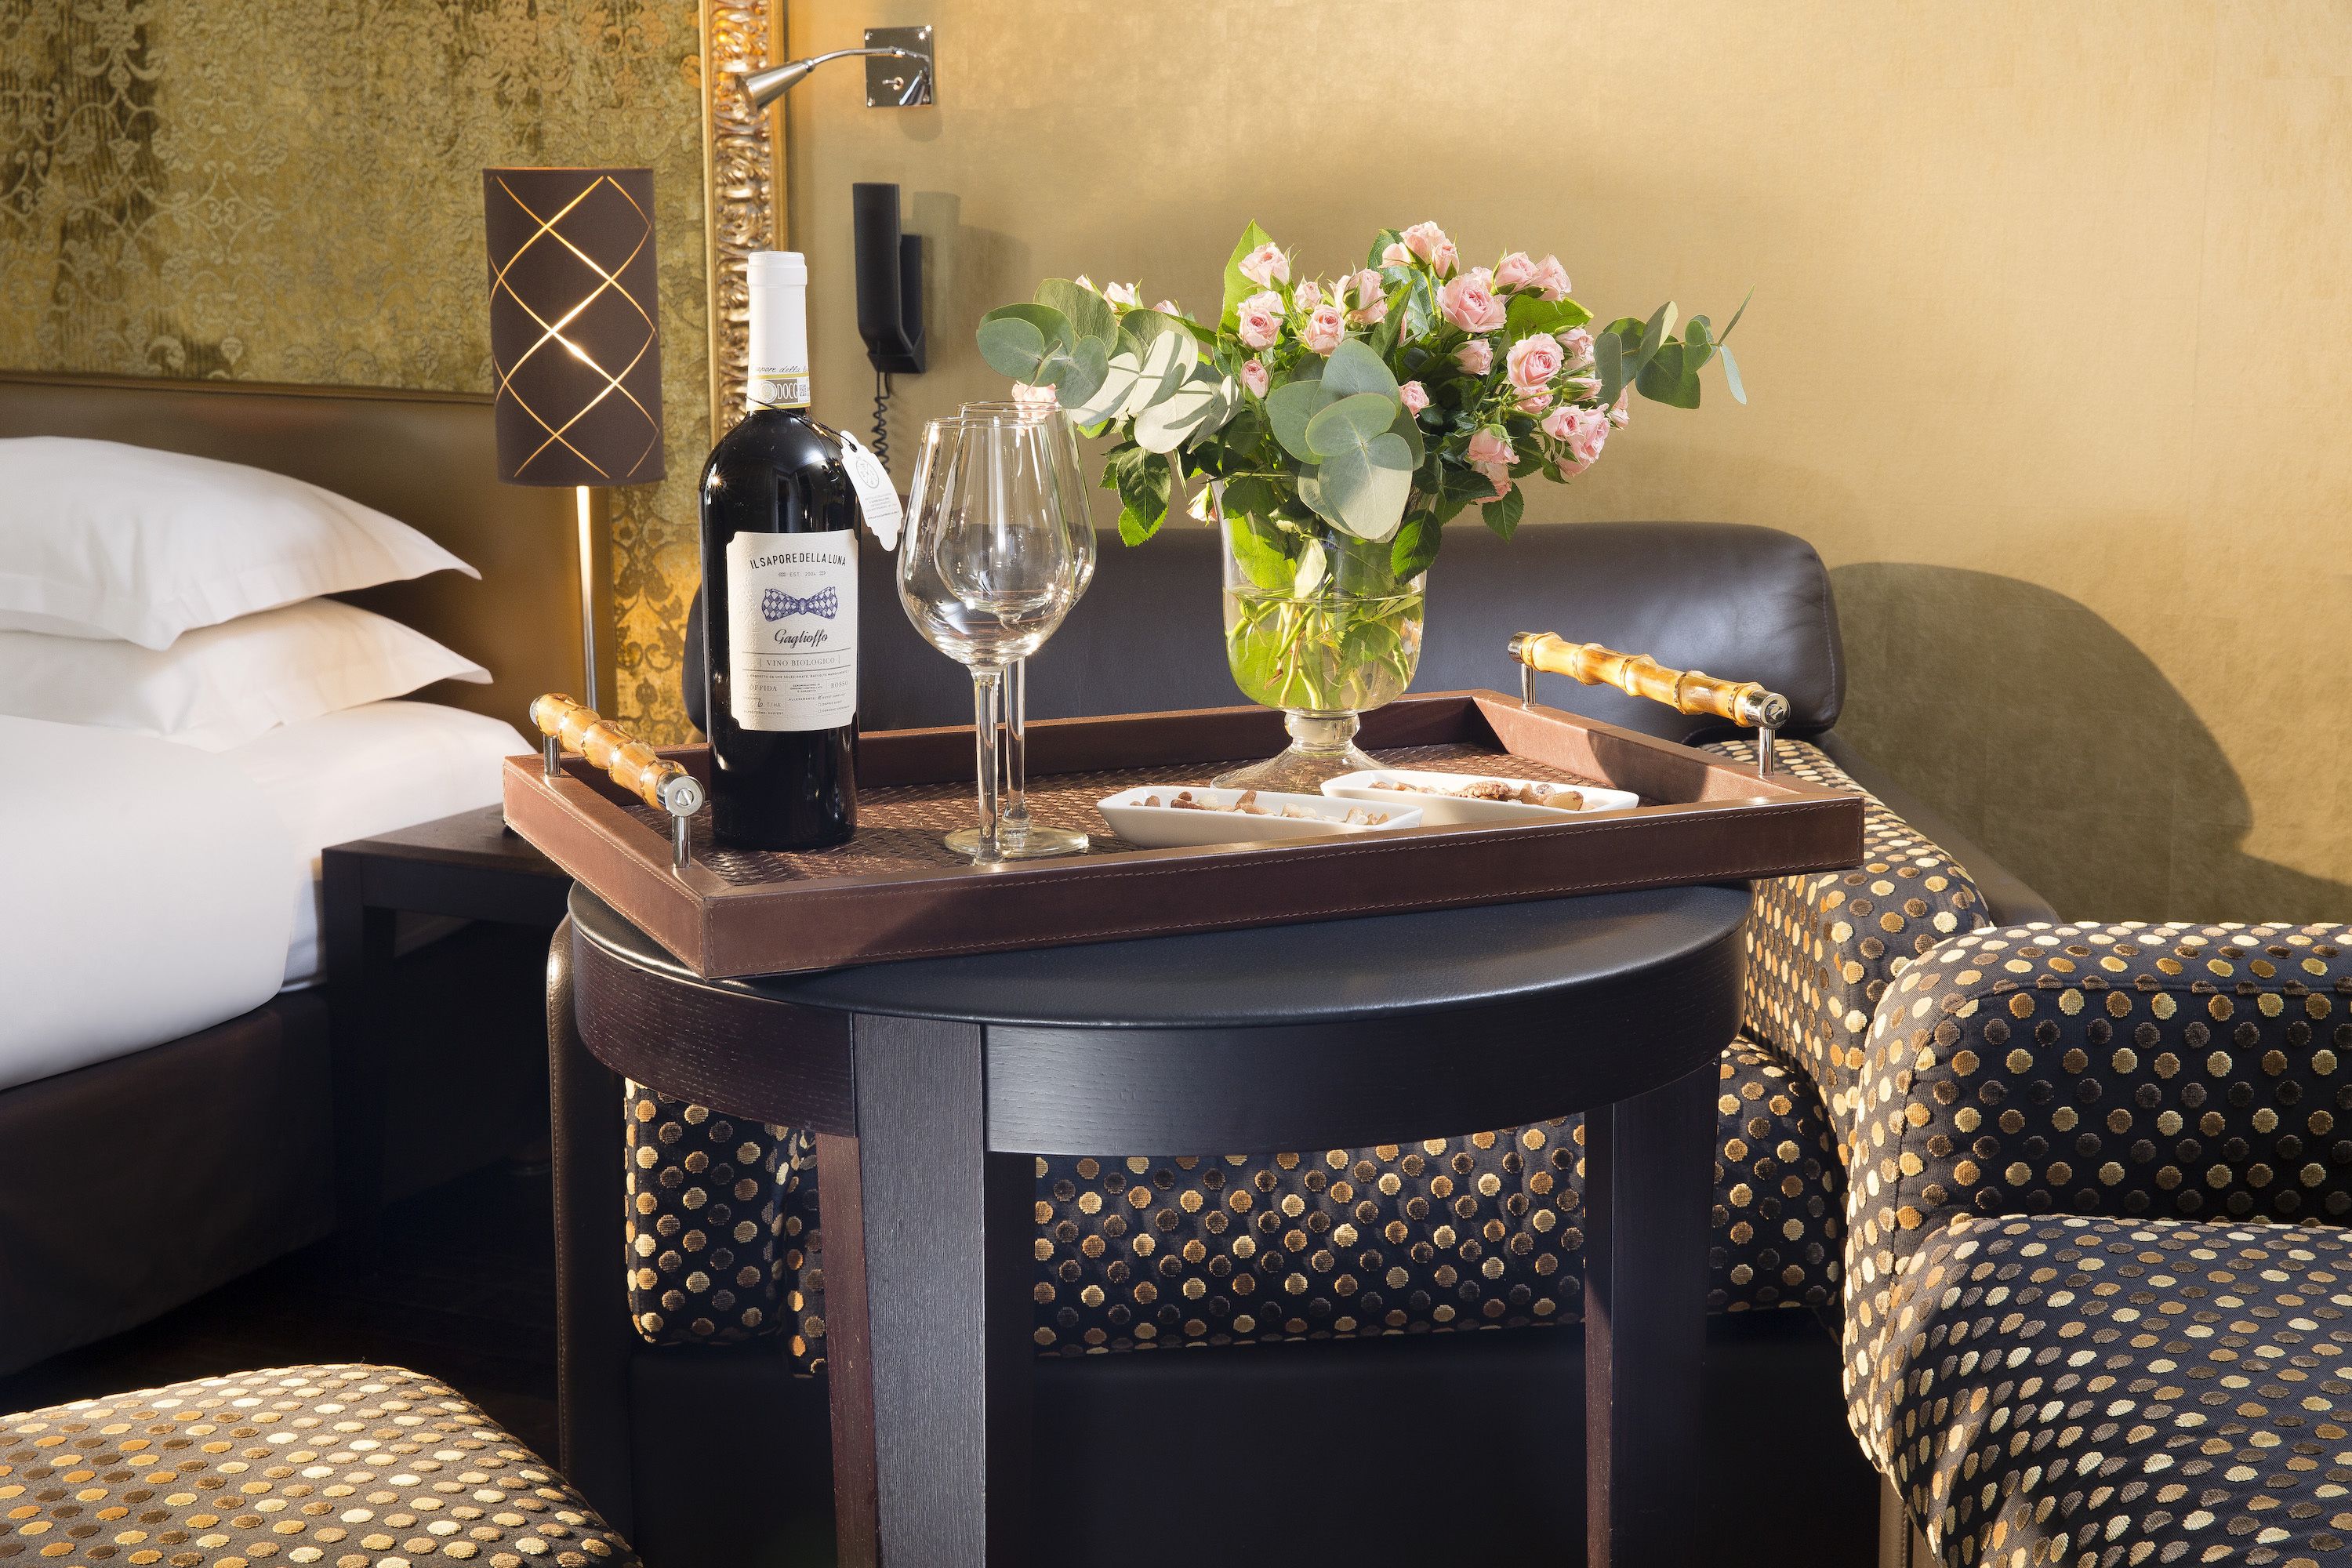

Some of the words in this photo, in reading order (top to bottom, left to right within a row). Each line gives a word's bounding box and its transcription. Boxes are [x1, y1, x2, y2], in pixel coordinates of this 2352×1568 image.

[779, 365, 800, 373] della
[750, 560, 760, 569] IL
[760, 554, 797, 568] SAPORE
[799, 553, 826, 563] DELLA
[828, 554, 847, 567] LUNA
[774, 629, 829, 649] Gaglioffo
[791, 657, 836, 666] BIOLOGICO
[830, 681, 849, 689] ROSSO
